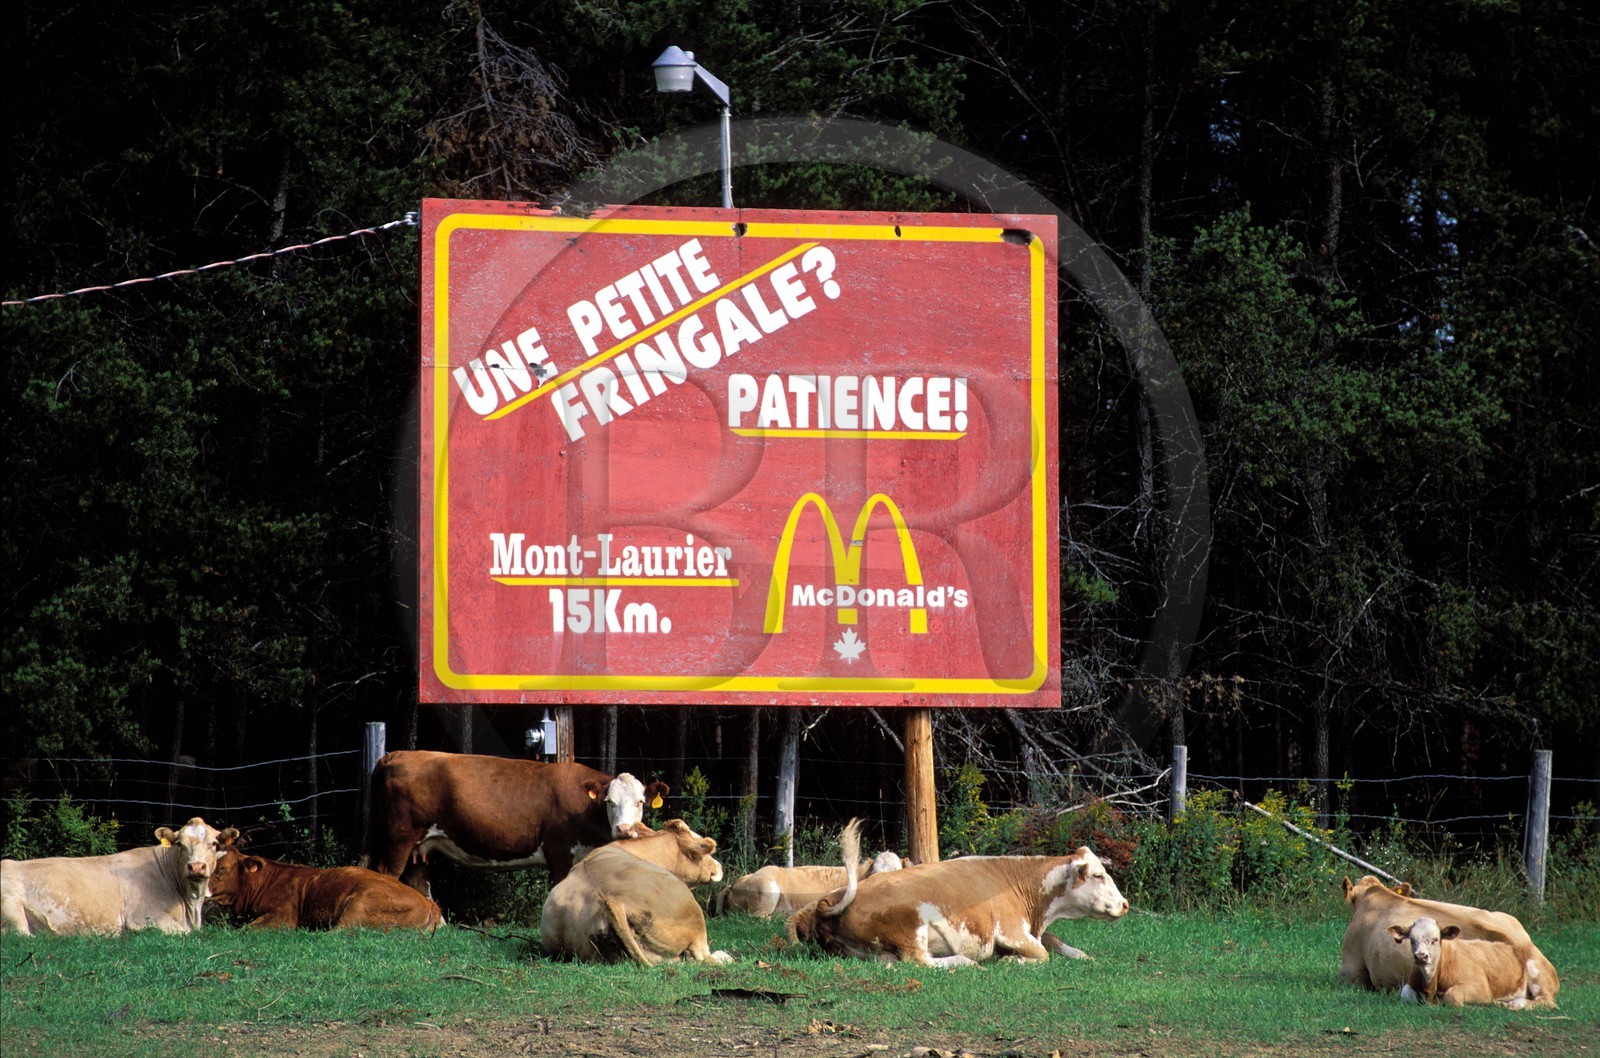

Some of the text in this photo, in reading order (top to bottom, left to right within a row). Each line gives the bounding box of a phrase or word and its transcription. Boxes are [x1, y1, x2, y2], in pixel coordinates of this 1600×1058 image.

[452, 239, 720, 415] UNE PETITE
[551, 247, 840, 442] FRINGALE?
[728, 372, 968, 431] PATIENCE!
[490, 532, 733, 577] Mont-Laurier
[550, 588, 672, 635] 15Km.
[792, 584, 968, 608] McDonald's
